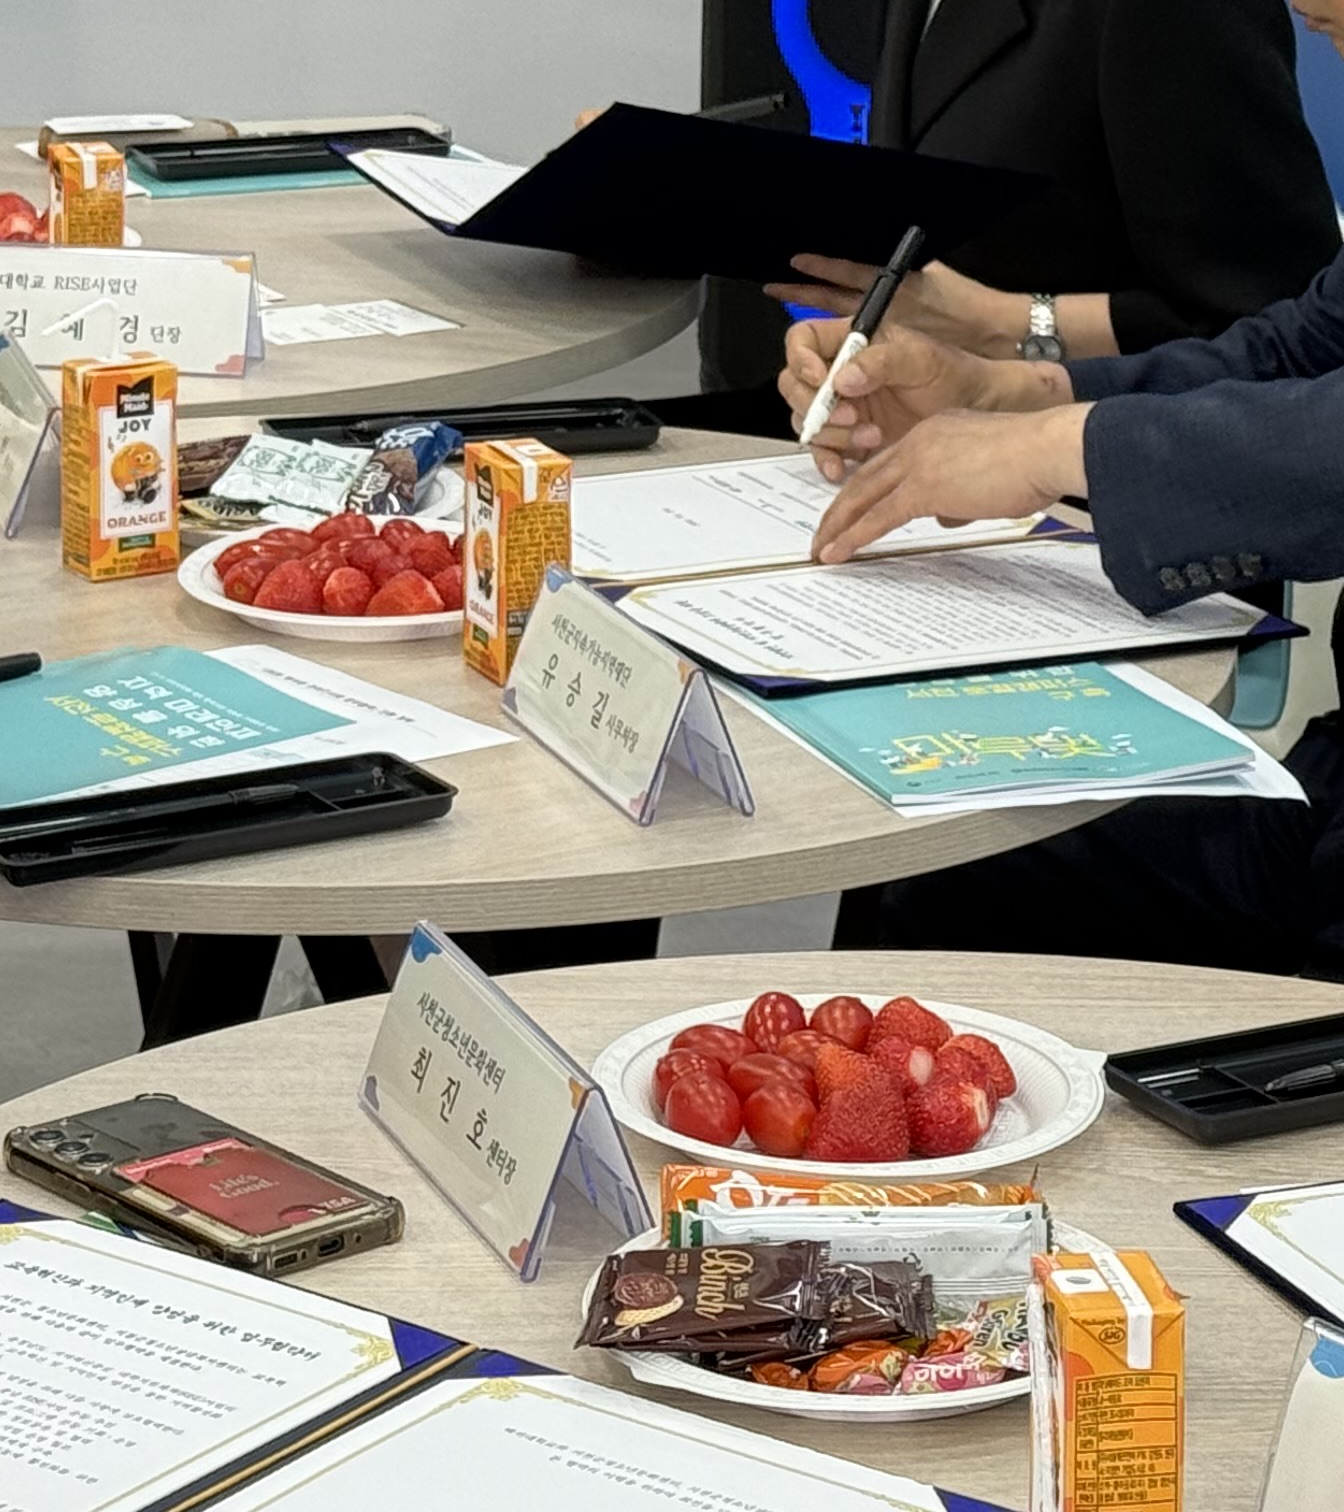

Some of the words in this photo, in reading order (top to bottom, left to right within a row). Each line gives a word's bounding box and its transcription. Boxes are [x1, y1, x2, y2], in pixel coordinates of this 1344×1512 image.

[54, 275, 137, 296] RISE사업단
[119, 418, 153, 434] JOY
[107, 510, 167, 530] ORANGE
[417, 991, 506, 1095] 서천군청소년문화센터
[486, 1138, 517, 1186] 센터장
[694, 1248, 754, 1322] Binch
